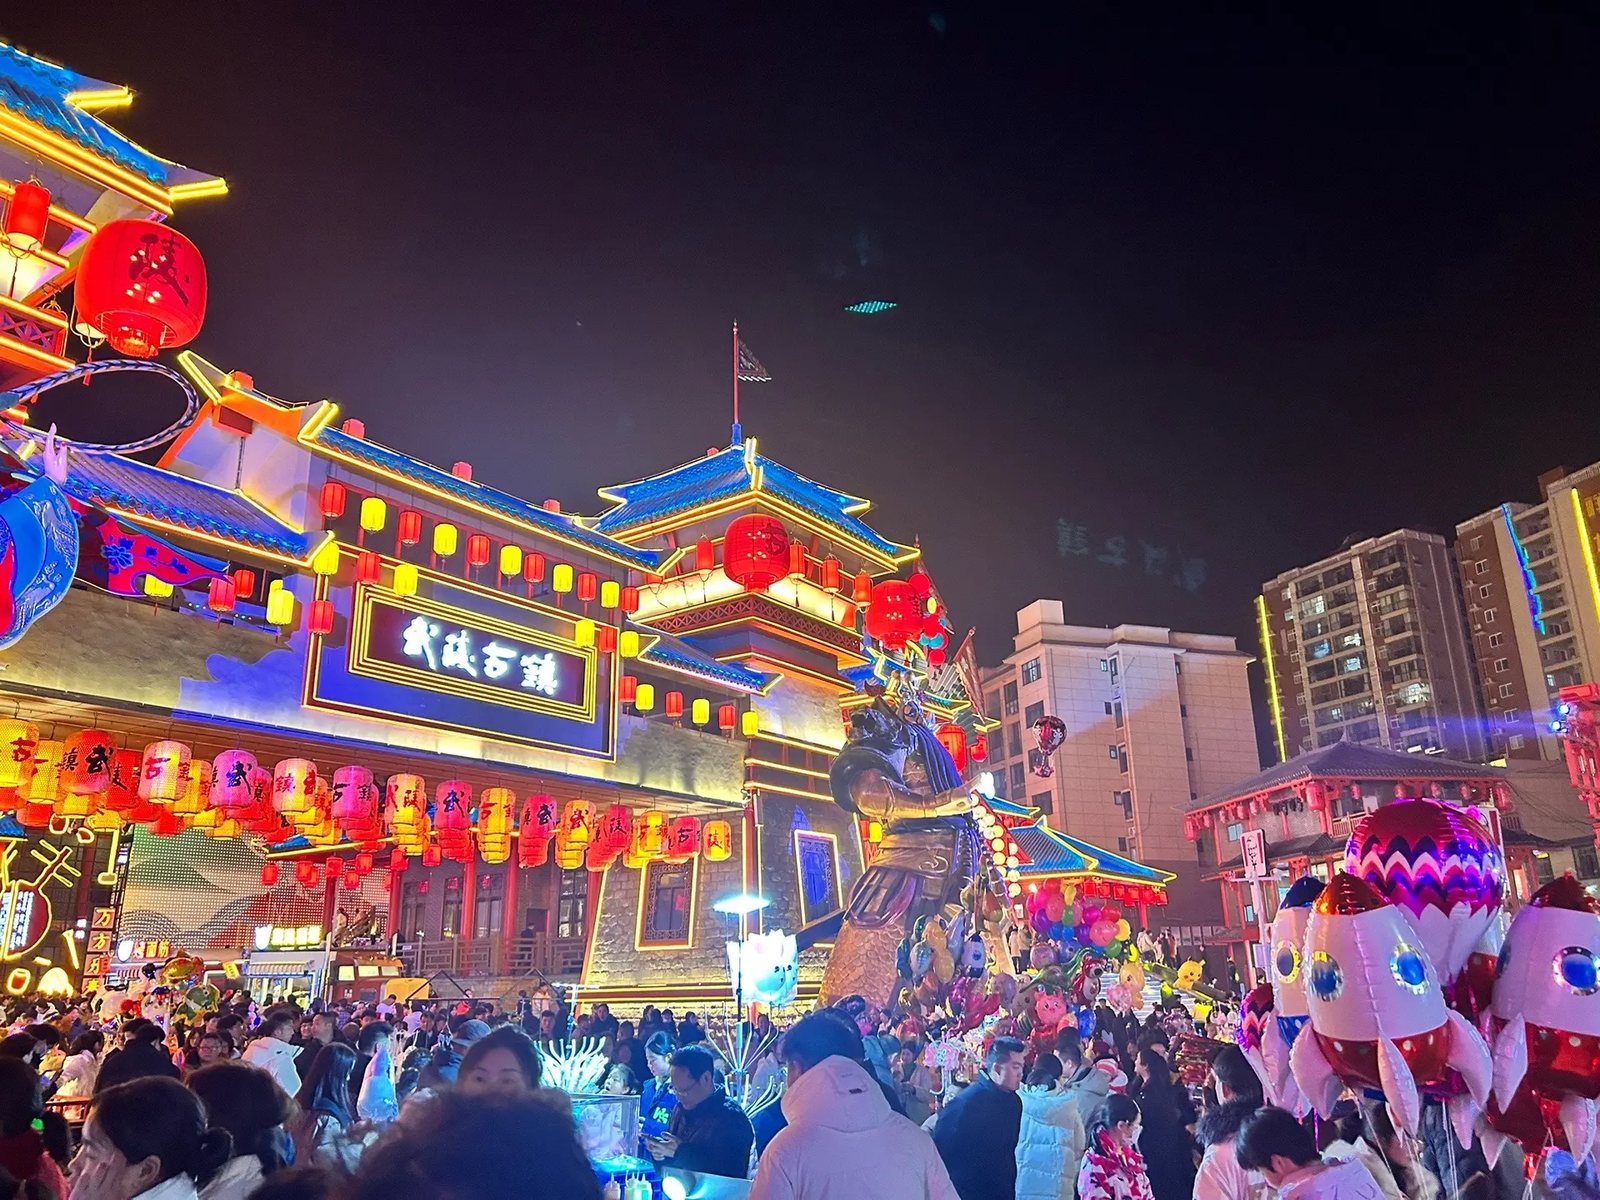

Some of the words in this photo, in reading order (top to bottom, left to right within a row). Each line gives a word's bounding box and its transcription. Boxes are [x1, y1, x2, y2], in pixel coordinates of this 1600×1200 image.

[10, 737, 37, 762] 古
[85, 744, 114, 782] 武
[226, 761, 252, 795] 武
[443, 789, 465, 818] 武
